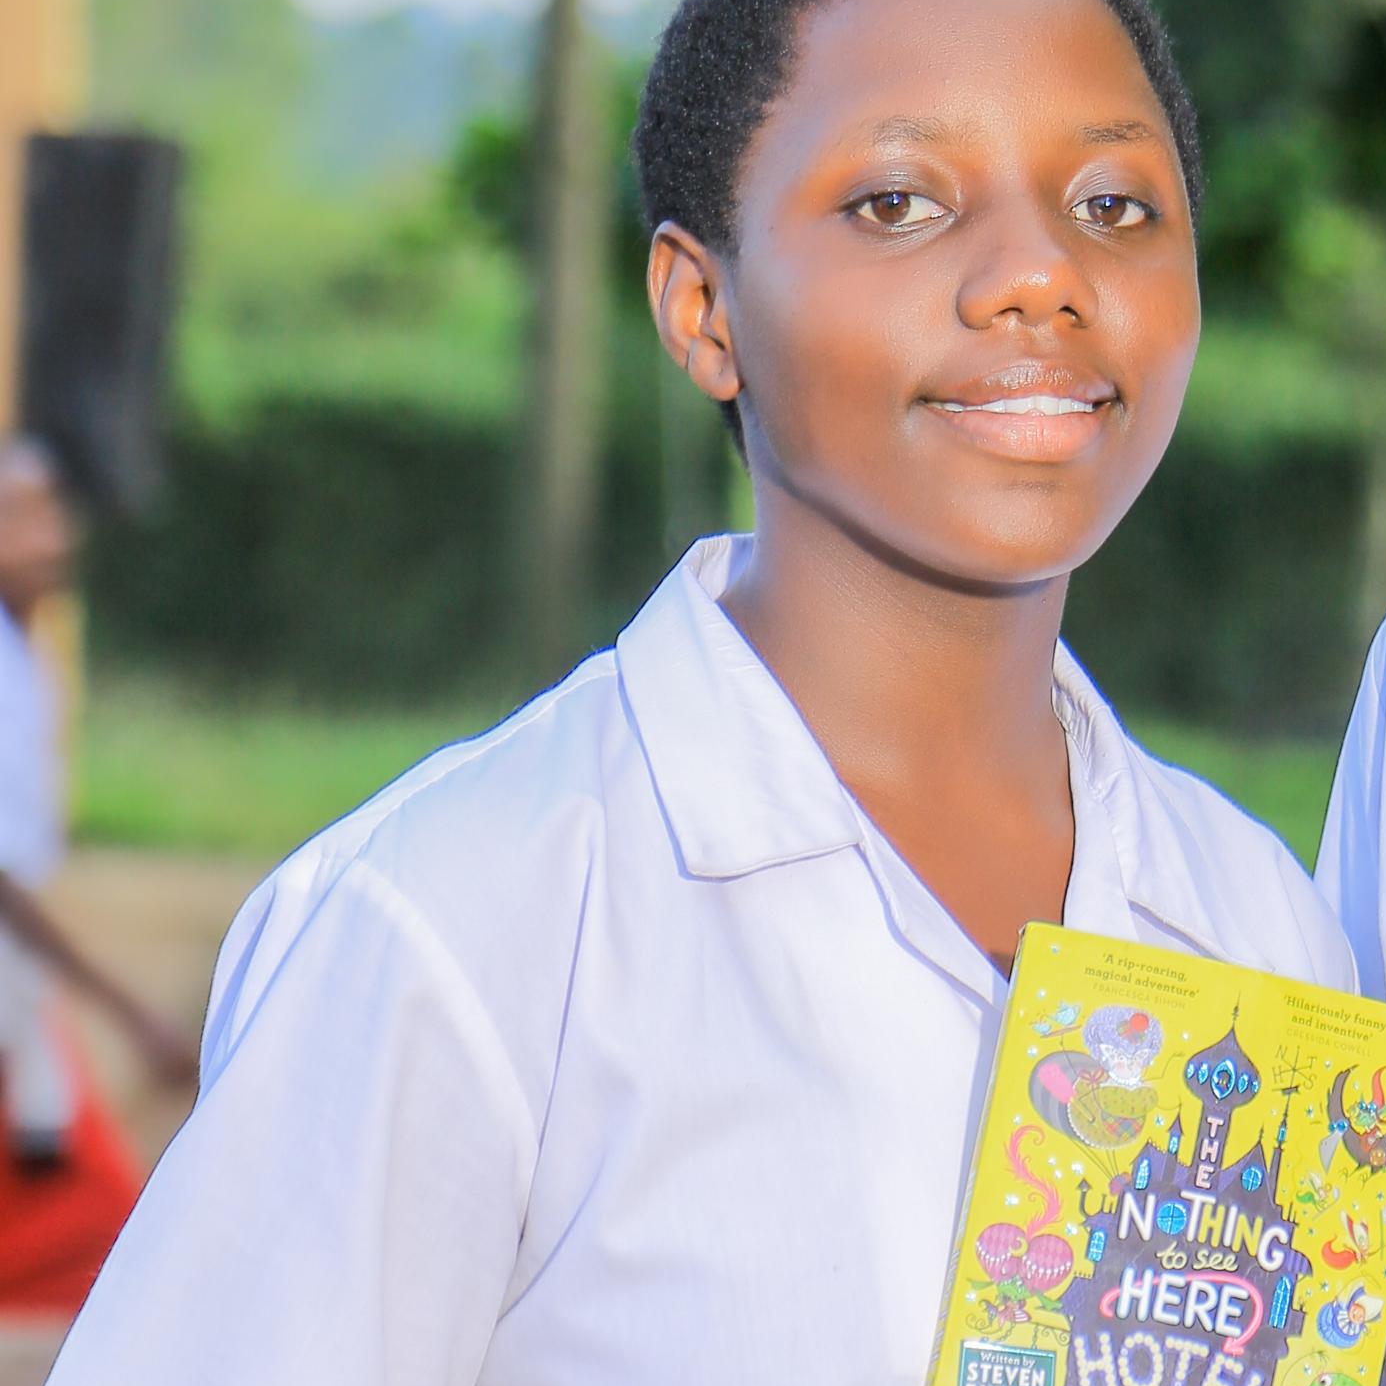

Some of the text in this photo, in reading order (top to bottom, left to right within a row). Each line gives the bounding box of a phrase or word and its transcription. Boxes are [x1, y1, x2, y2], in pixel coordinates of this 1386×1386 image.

[1084, 966, 1133, 983] magical
[1118, 956, 1188, 982] rip-roaring,
[1291, 1014, 1312, 1027] and
[1354, 1013, 1386, 1033] funny
[1195, 1116, 1223, 1189] THE
[1117, 1189, 1289, 1272] NOTHING
[1156, 1241, 1239, 1272] to see
[1116, 1266, 1249, 1338] HERE
[980, 1351, 1036, 1369] Written by
